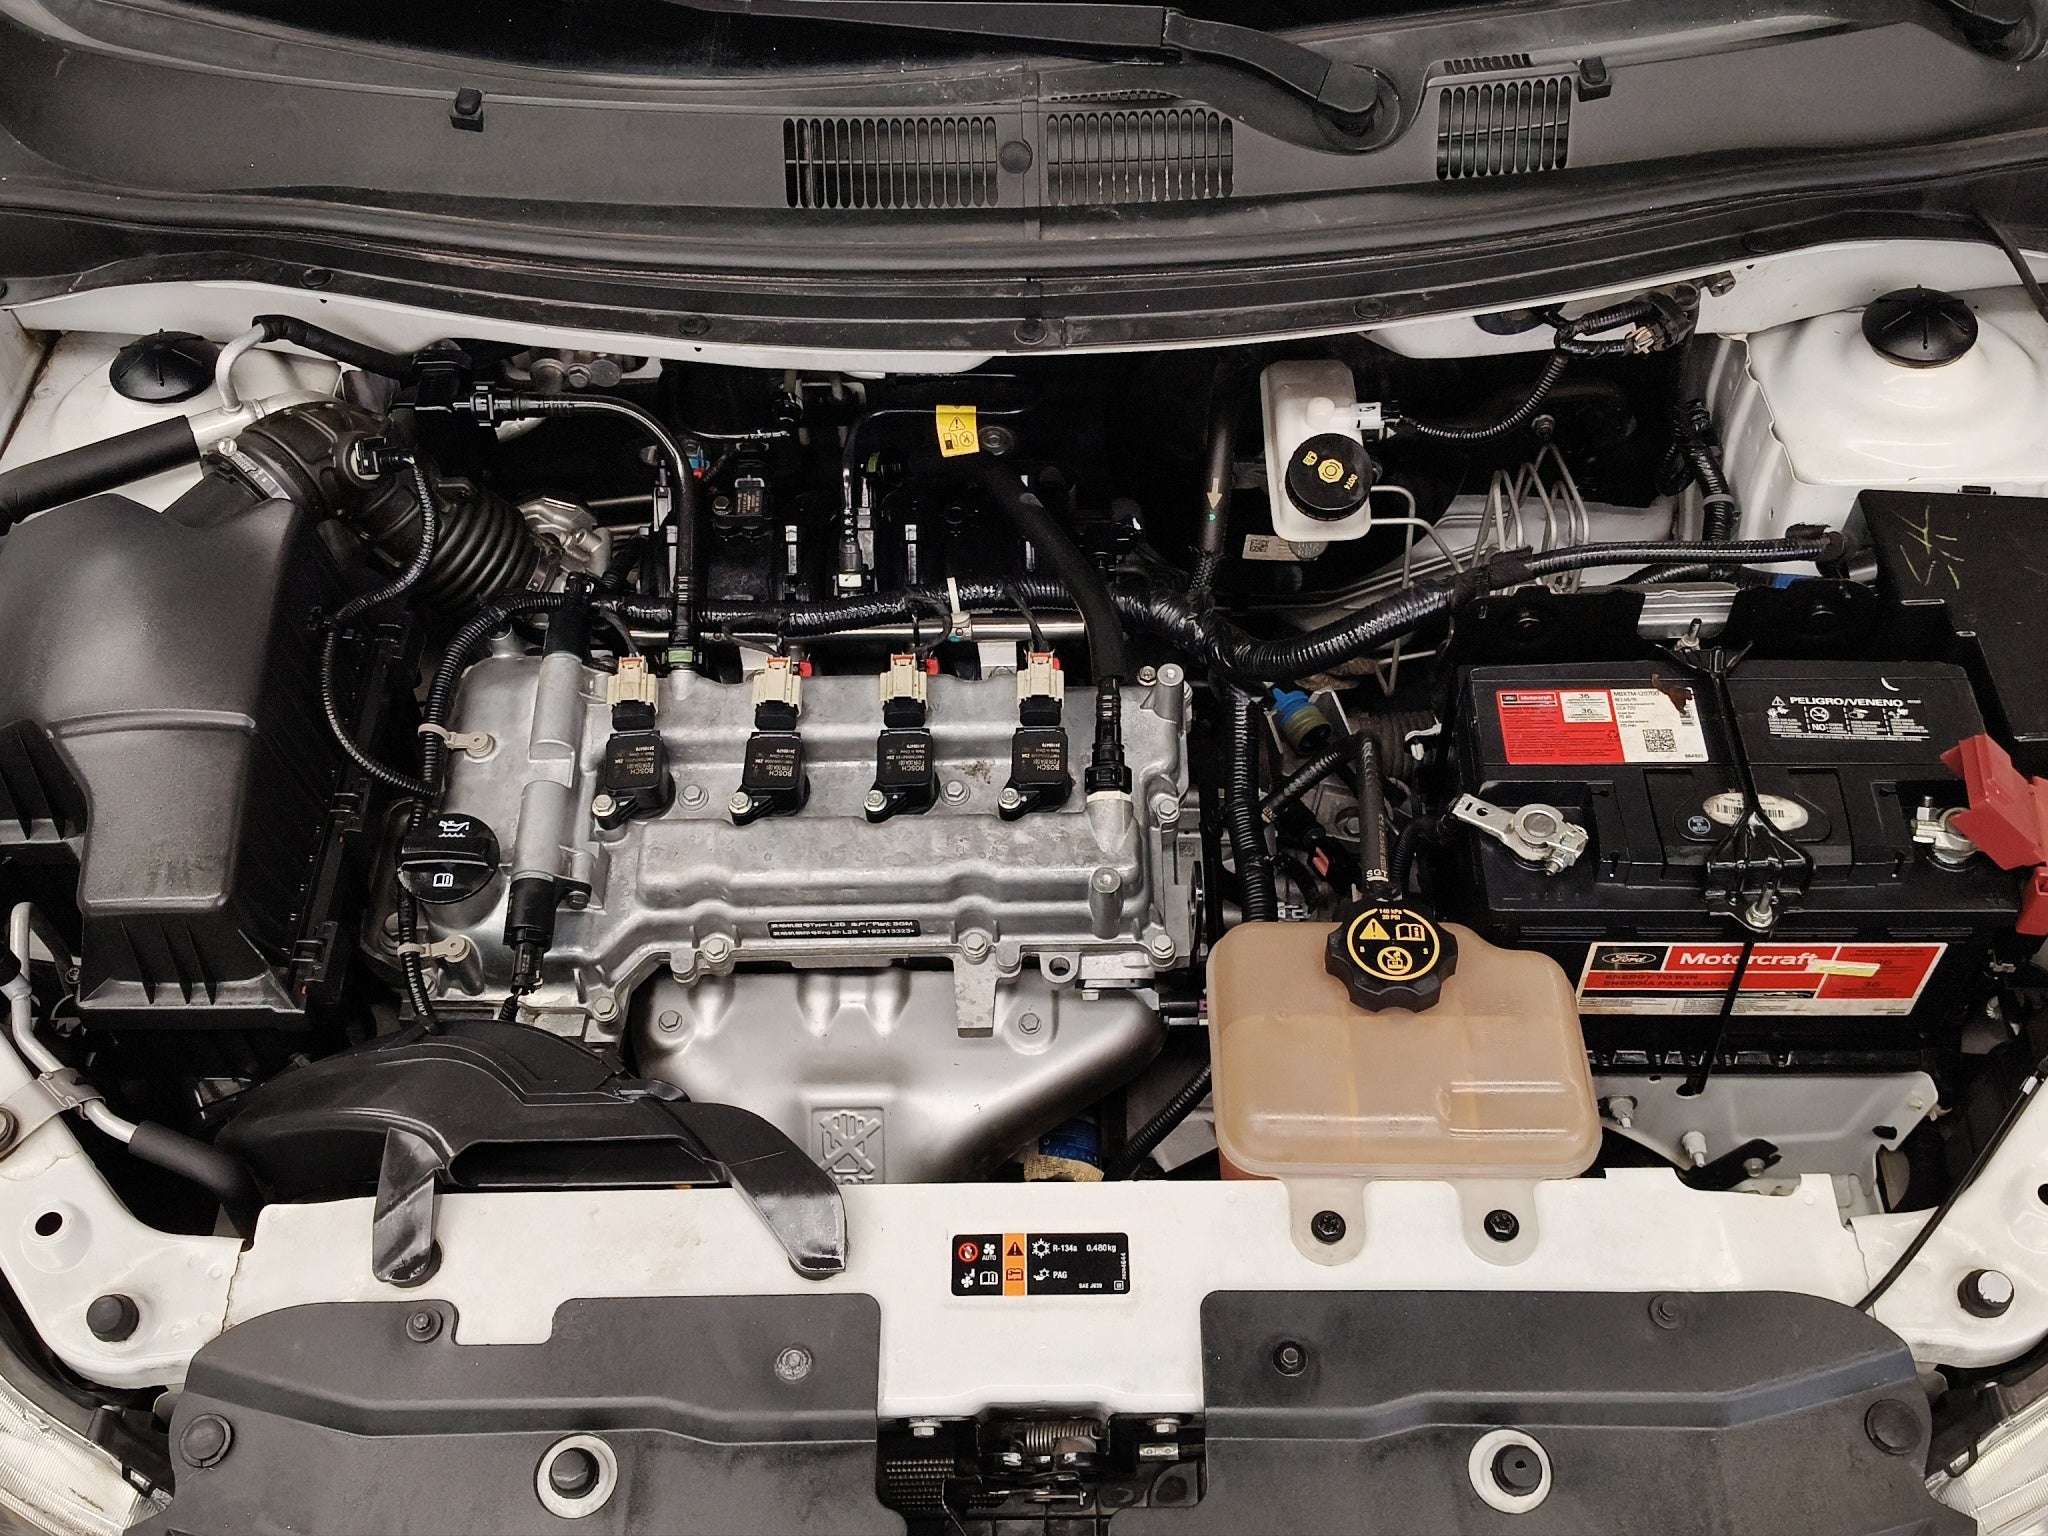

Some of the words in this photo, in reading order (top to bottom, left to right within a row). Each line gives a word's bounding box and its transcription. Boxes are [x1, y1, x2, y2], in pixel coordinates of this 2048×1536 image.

[1344, 474, 1358, 490] DOT4
[1790, 696, 1904, 707] PELIGRO/VENENO
[1611, 952, 1648, 964] Ford
[1680, 952, 1818, 965] Motorcraft
